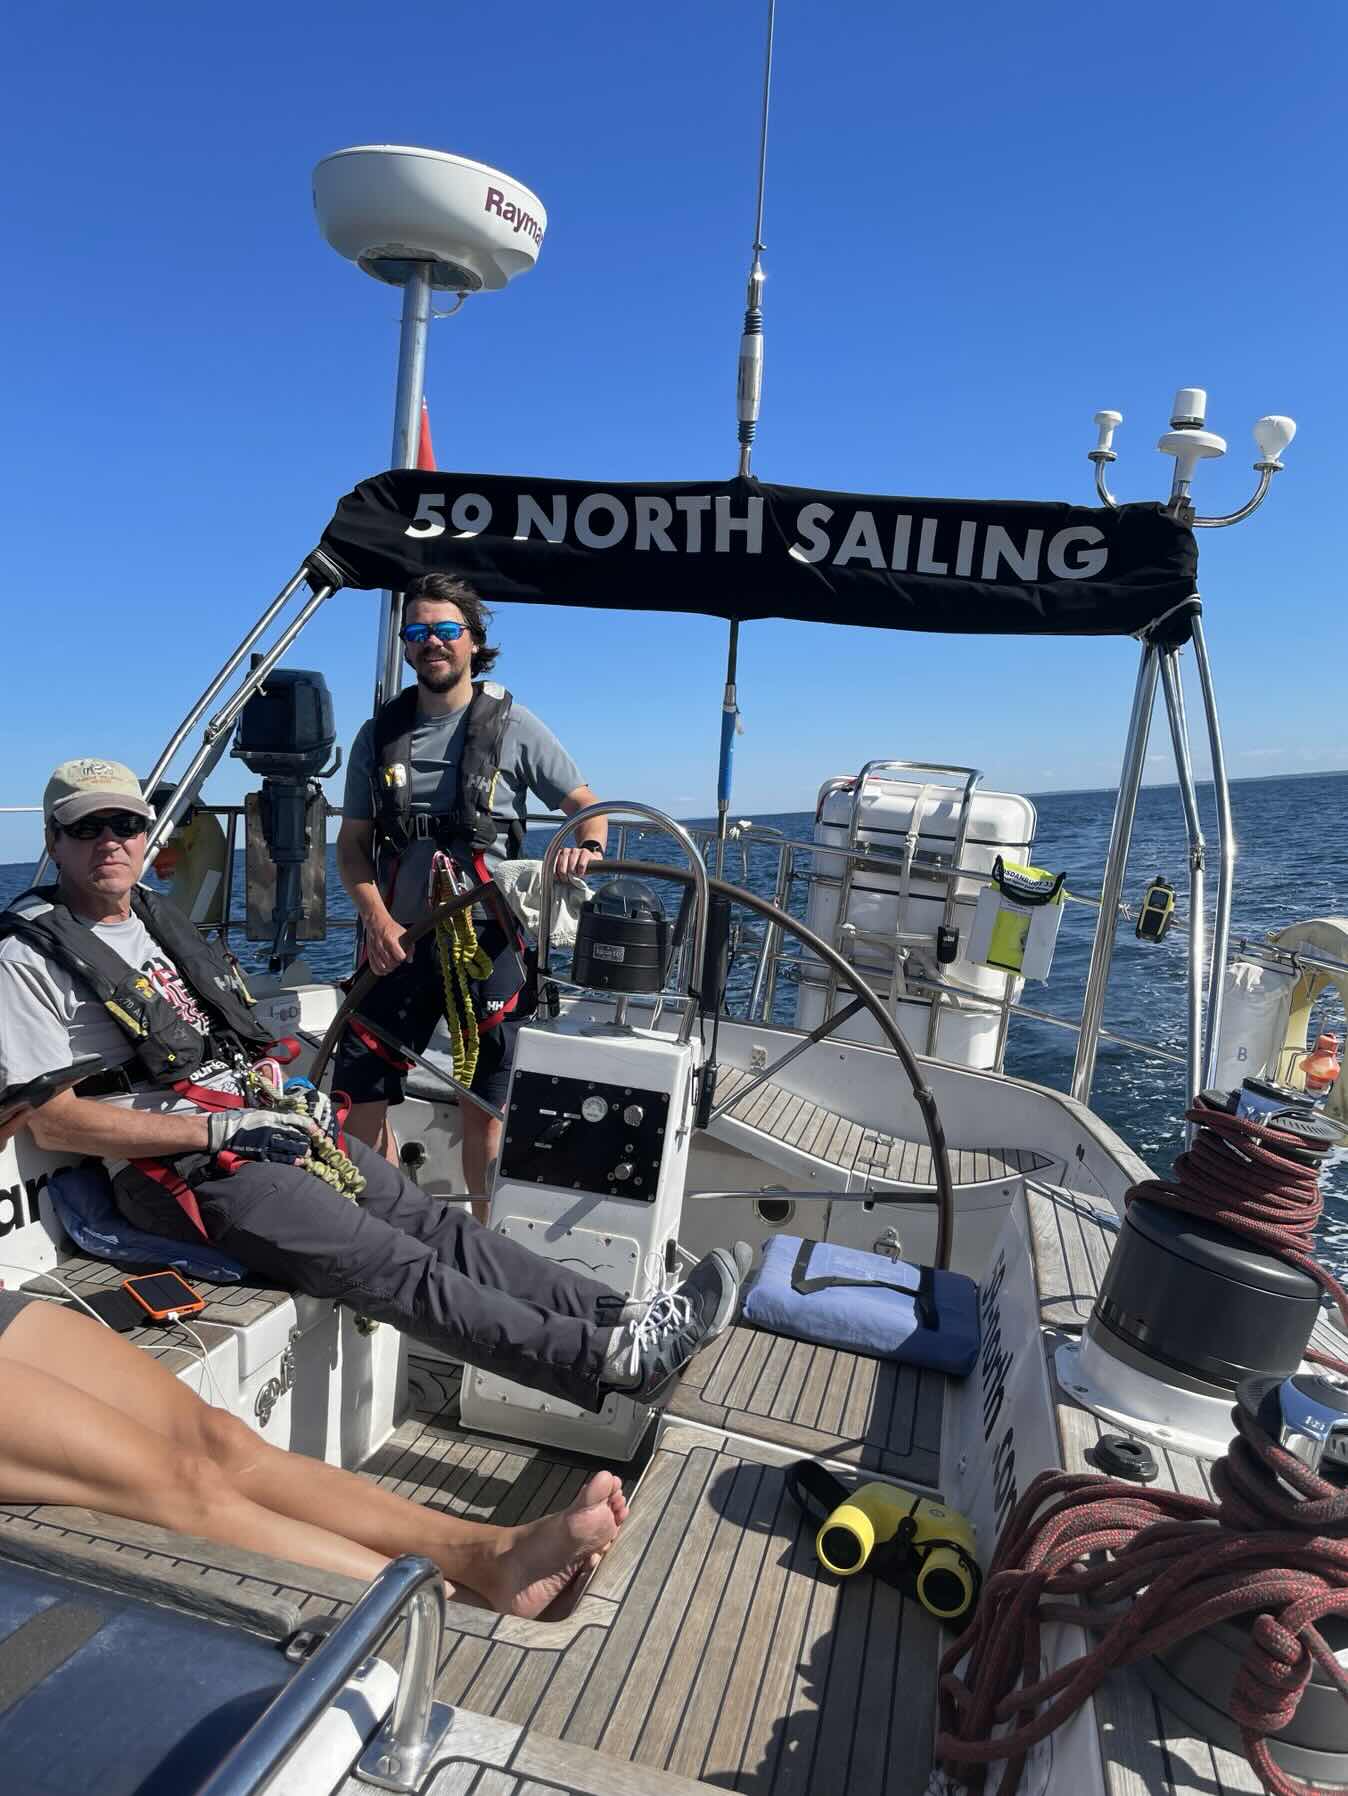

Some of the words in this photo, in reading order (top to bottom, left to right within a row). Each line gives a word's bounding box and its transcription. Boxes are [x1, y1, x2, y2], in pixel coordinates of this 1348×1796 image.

[485, 186, 544, 248] Rayma
[404, 493, 493, 538] 59
[512, 493, 764, 553] NORTH
[788, 502, 1109, 581] SAILING
[487, 1000, 505, 1011] HH
[1238, 1046, 1248, 1062] B
